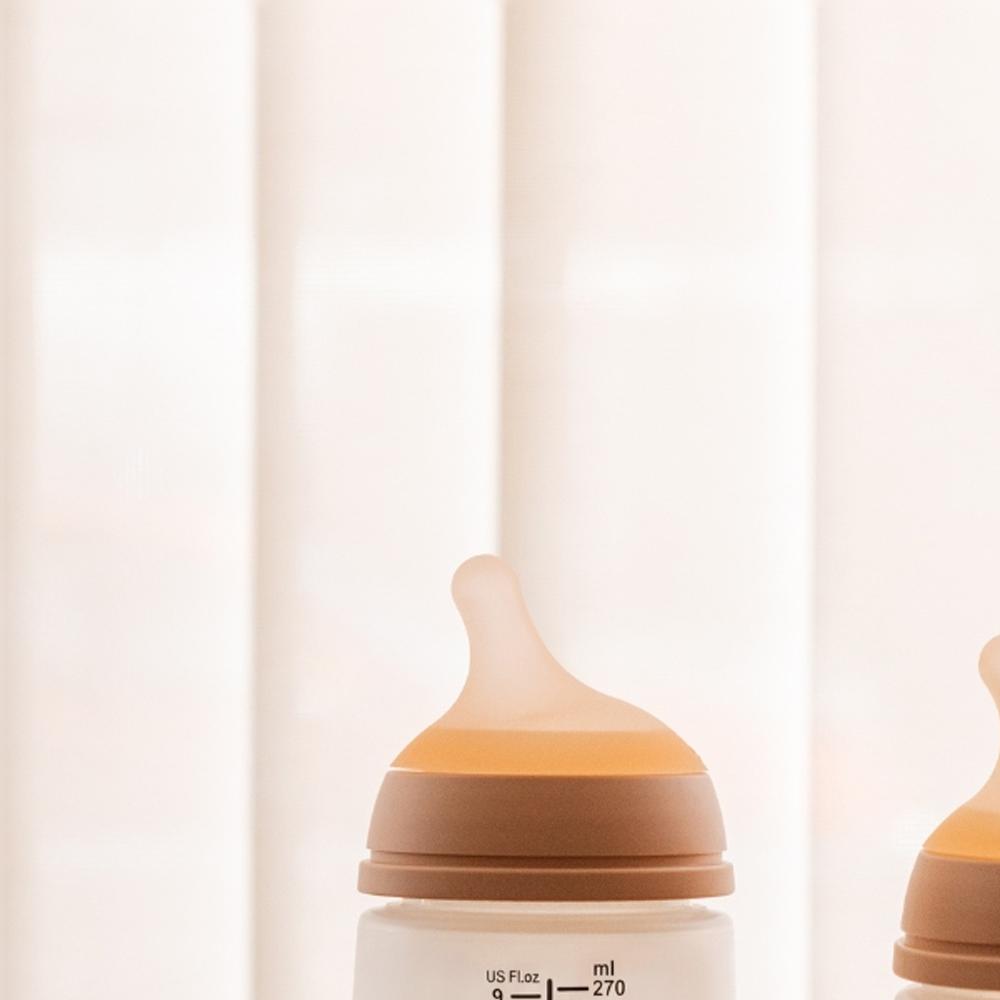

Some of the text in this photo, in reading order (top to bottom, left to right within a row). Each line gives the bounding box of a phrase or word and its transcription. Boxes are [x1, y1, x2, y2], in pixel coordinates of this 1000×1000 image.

[486, 970, 541, 984] US Fl.oz
[593, 960, 615, 977] ml
[592, 979, 626, 997] 270
